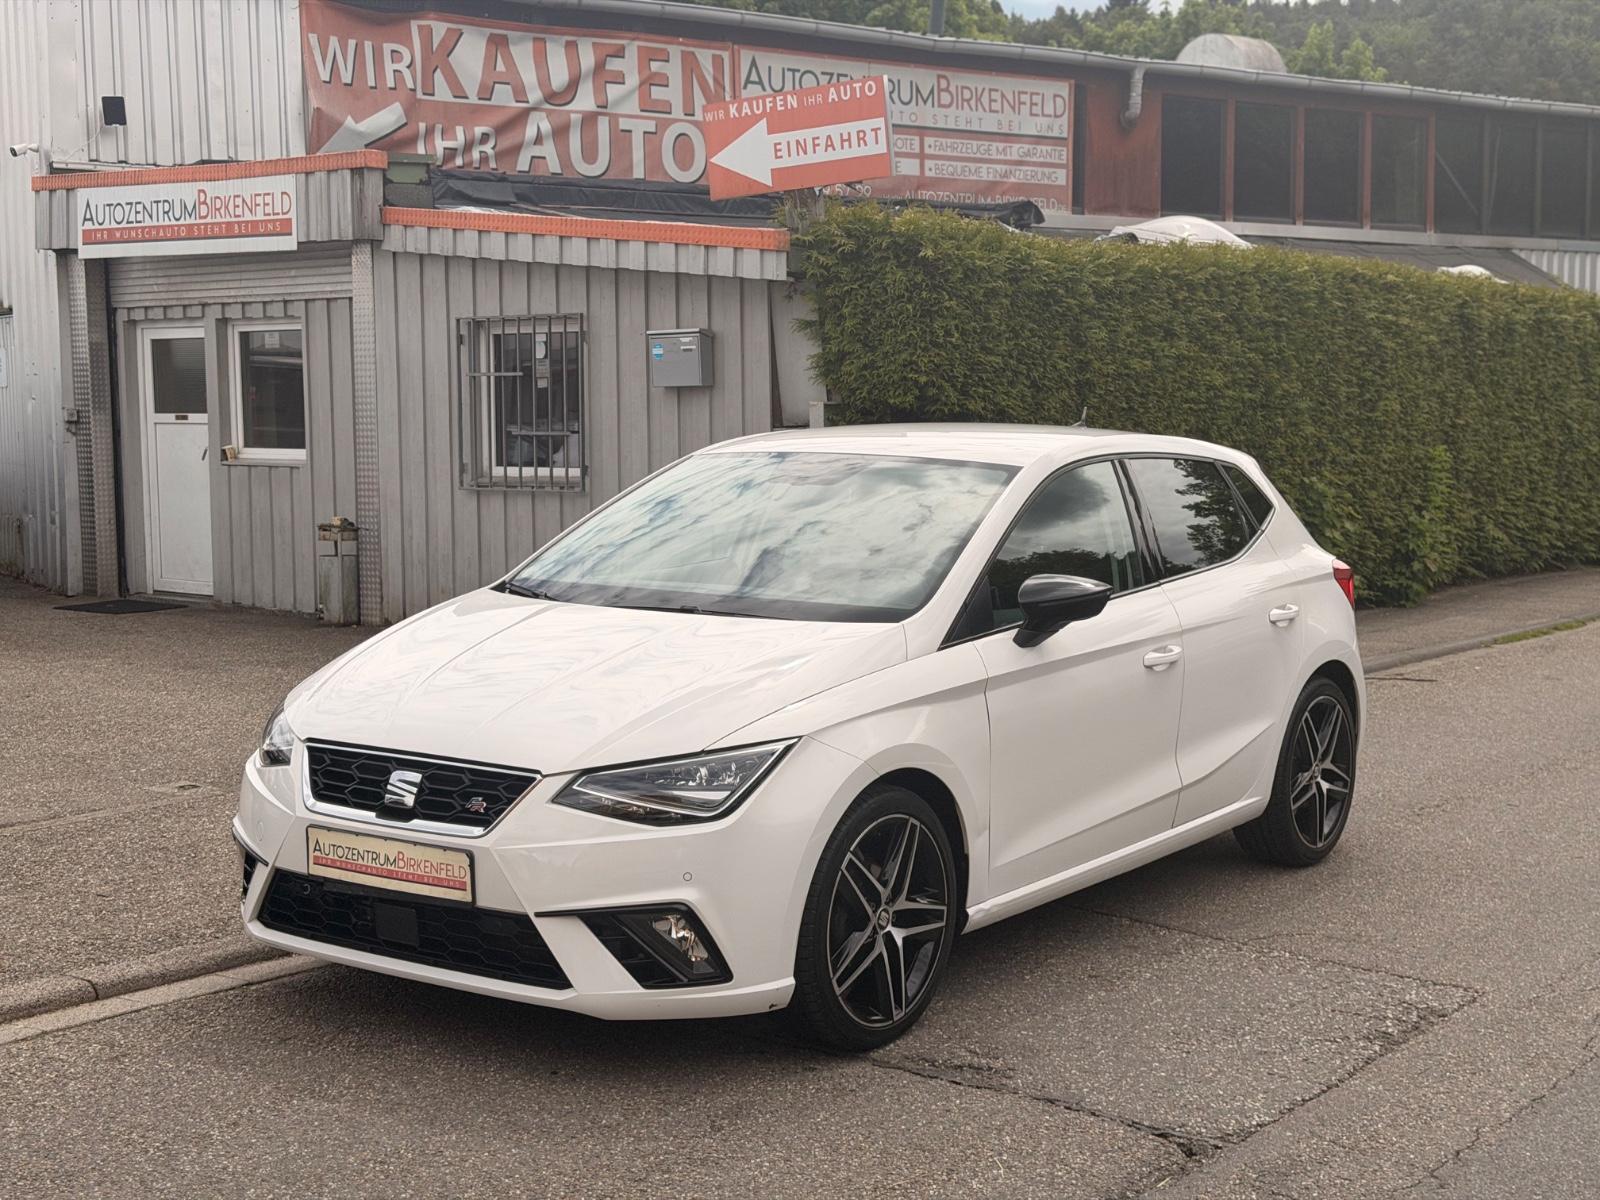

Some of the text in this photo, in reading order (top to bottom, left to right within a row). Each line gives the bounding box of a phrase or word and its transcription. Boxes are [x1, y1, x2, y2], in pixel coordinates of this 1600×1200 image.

[308, 24, 726, 116] WIR KAUFEN
[704, 81, 876, 122] WIR KAUFEN IHR AUTO
[932, 114, 983, 128] STEHT
[997, 120, 1022, 131] BEI
[1035, 122, 1063, 135] UNS
[417, 112, 708, 183] IHR AUTO
[774, 128, 881, 160] EINFAHRT
[934, 140, 993, 156] FAHRZEUGE
[996, 145, 1014, 156] MIT
[935, 163, 1058, 182] BEQUEME FINANZIERUNG
[92, 221, 281, 241] IHR WUNSCHAUTO STEHT BEI UNS
